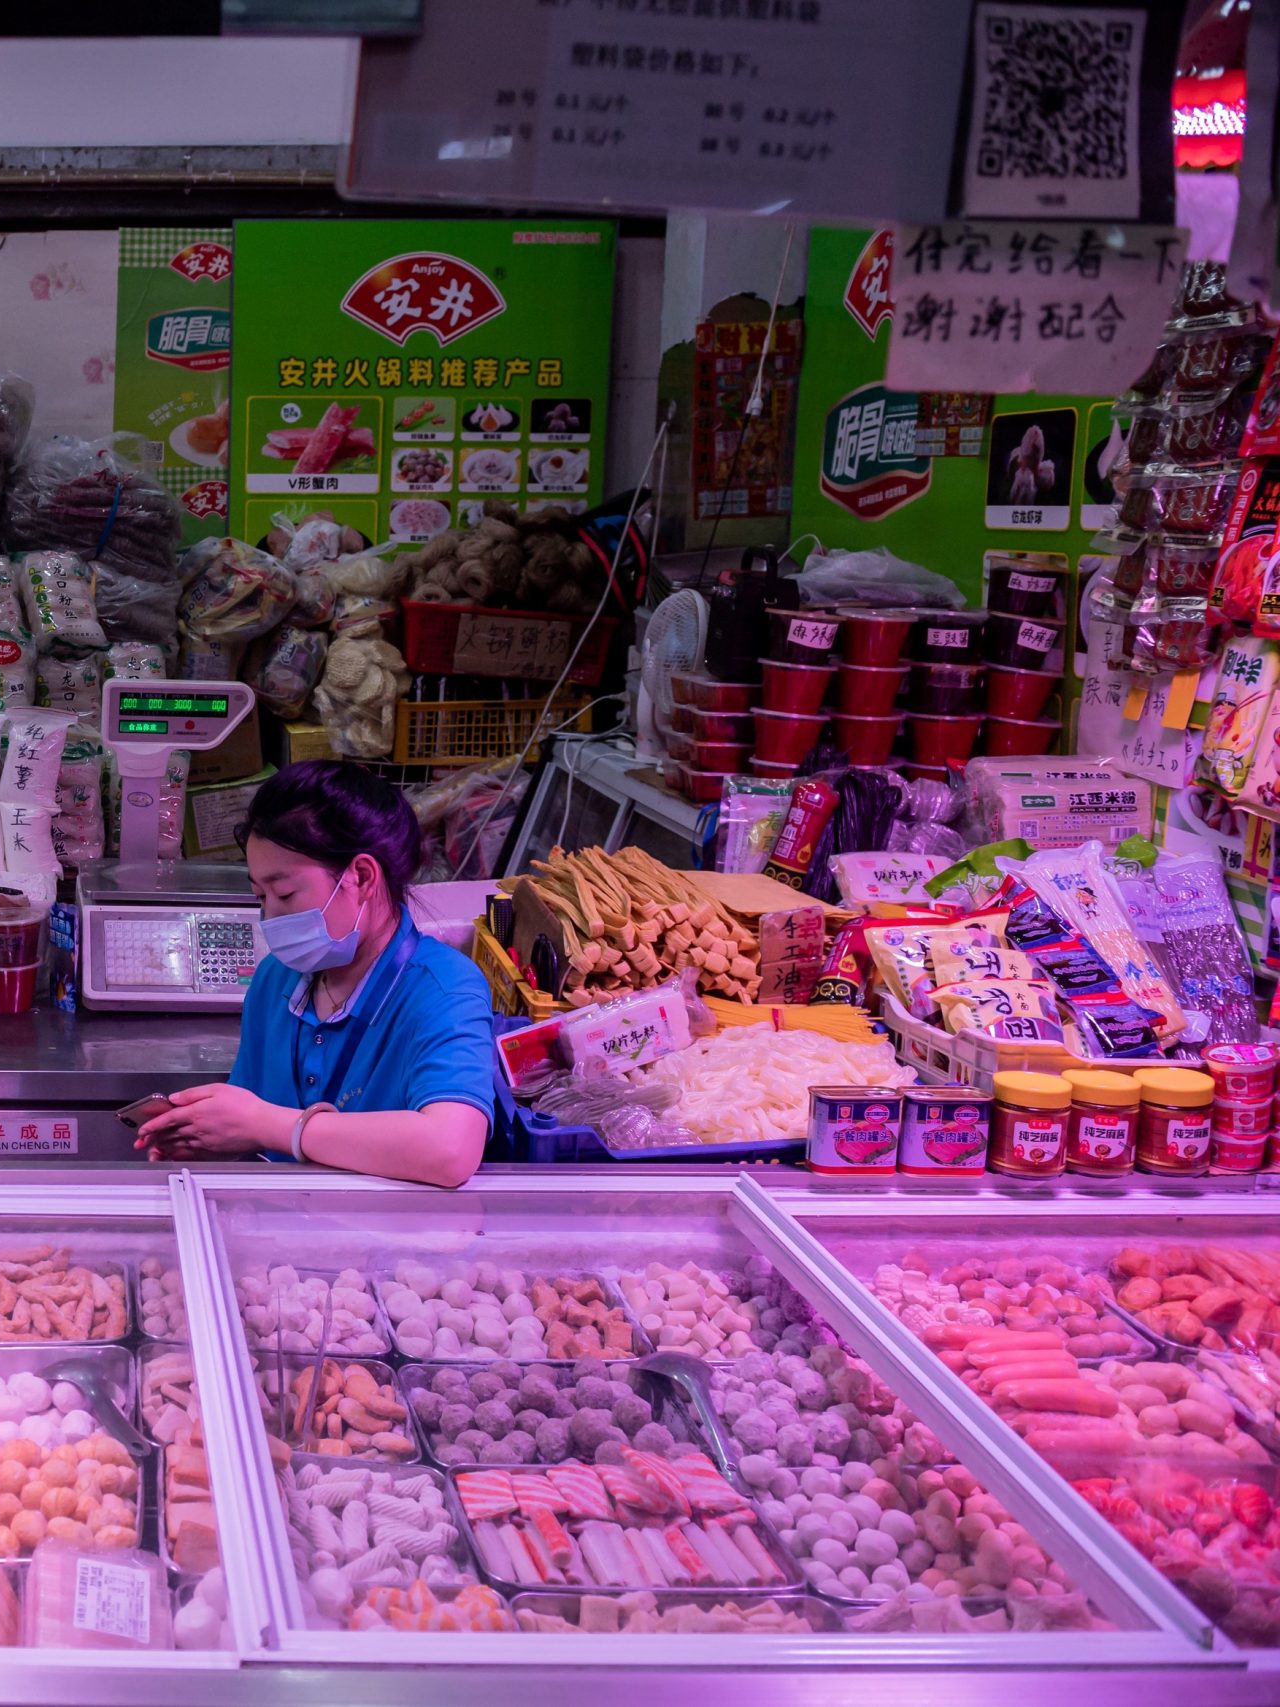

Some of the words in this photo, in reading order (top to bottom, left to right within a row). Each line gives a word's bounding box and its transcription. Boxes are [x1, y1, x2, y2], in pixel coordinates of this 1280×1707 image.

[182, 253, 231, 278] 安井
[411, 261, 446, 278] Anjoy
[373, 277, 474, 327] 安井
[902, 294, 1126, 343] 谢谢配合
[158, 315, 212, 352] 脆骨
[279, 357, 564, 388] 安井火锅料推荐产品
[831, 399, 886, 480] 脆骨
[288, 476, 339, 491] V形蟹肉
[61, 672, 76, 712] 龙口
[14, 723, 45, 790] 纯红薯
[1070, 791, 1137, 806] 江西米粉
[11, 807, 32, 853] 玉米
[874, 869, 926, 882] 切片年糕
[601, 1025, 659, 1053] 切片年糕
[833, 1130, 892, 1143] 午餐肉罐头
[922, 1131, 980, 1144] 午餐肉罐头
[1018, 1130, 1059, 1143] 纯芝麻酱
[1084, 1126, 1126, 1139] 纯芝麻酱
[1172, 1127, 1210, 1139] 纯芝麻酱
[11, 1141, 50, 1151] CHENG
[52, 1141, 71, 1150] PIN
